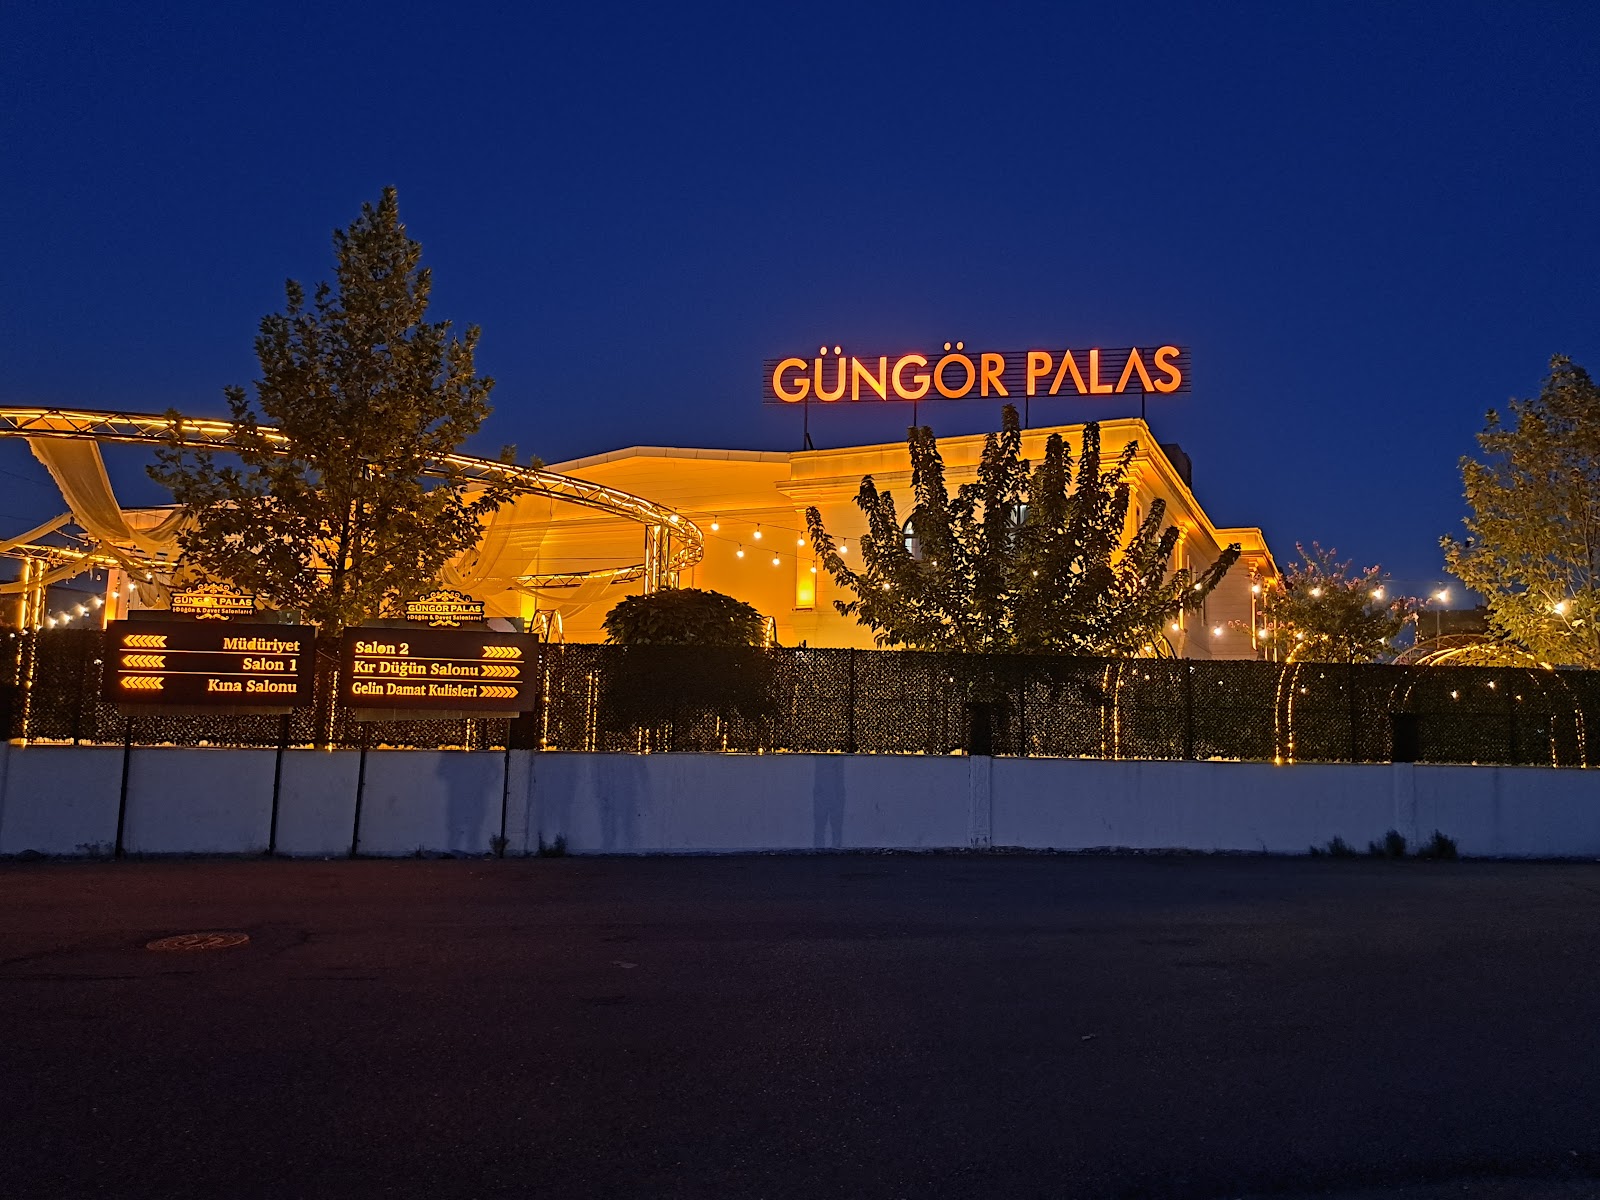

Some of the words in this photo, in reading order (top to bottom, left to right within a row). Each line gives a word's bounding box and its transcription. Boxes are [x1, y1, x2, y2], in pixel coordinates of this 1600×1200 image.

[772, 341, 1009, 402] GÜNGÖR
[1027, 346, 1182, 395] PALAS
[220, 598, 252, 606] PALAS
[408, 604, 449, 612] GÜNGÖR
[223, 637, 300, 654] Müdüriyet
[355, 641, 396, 654] Salon
[399, 642, 409, 655] 2
[243, 657, 284, 671] Salon
[289, 659, 298, 671] 1
[353, 661, 376, 673] Kır
[379, 662, 427, 676] Düğün
[430, 663, 479, 676] Salonu
[208, 679, 242, 691] Kına
[246, 680, 297, 693] Salonu
[352, 682, 384, 695] Gelin
[386, 683, 427, 696] Damat
[428, 684, 478, 697] Kulisleri
